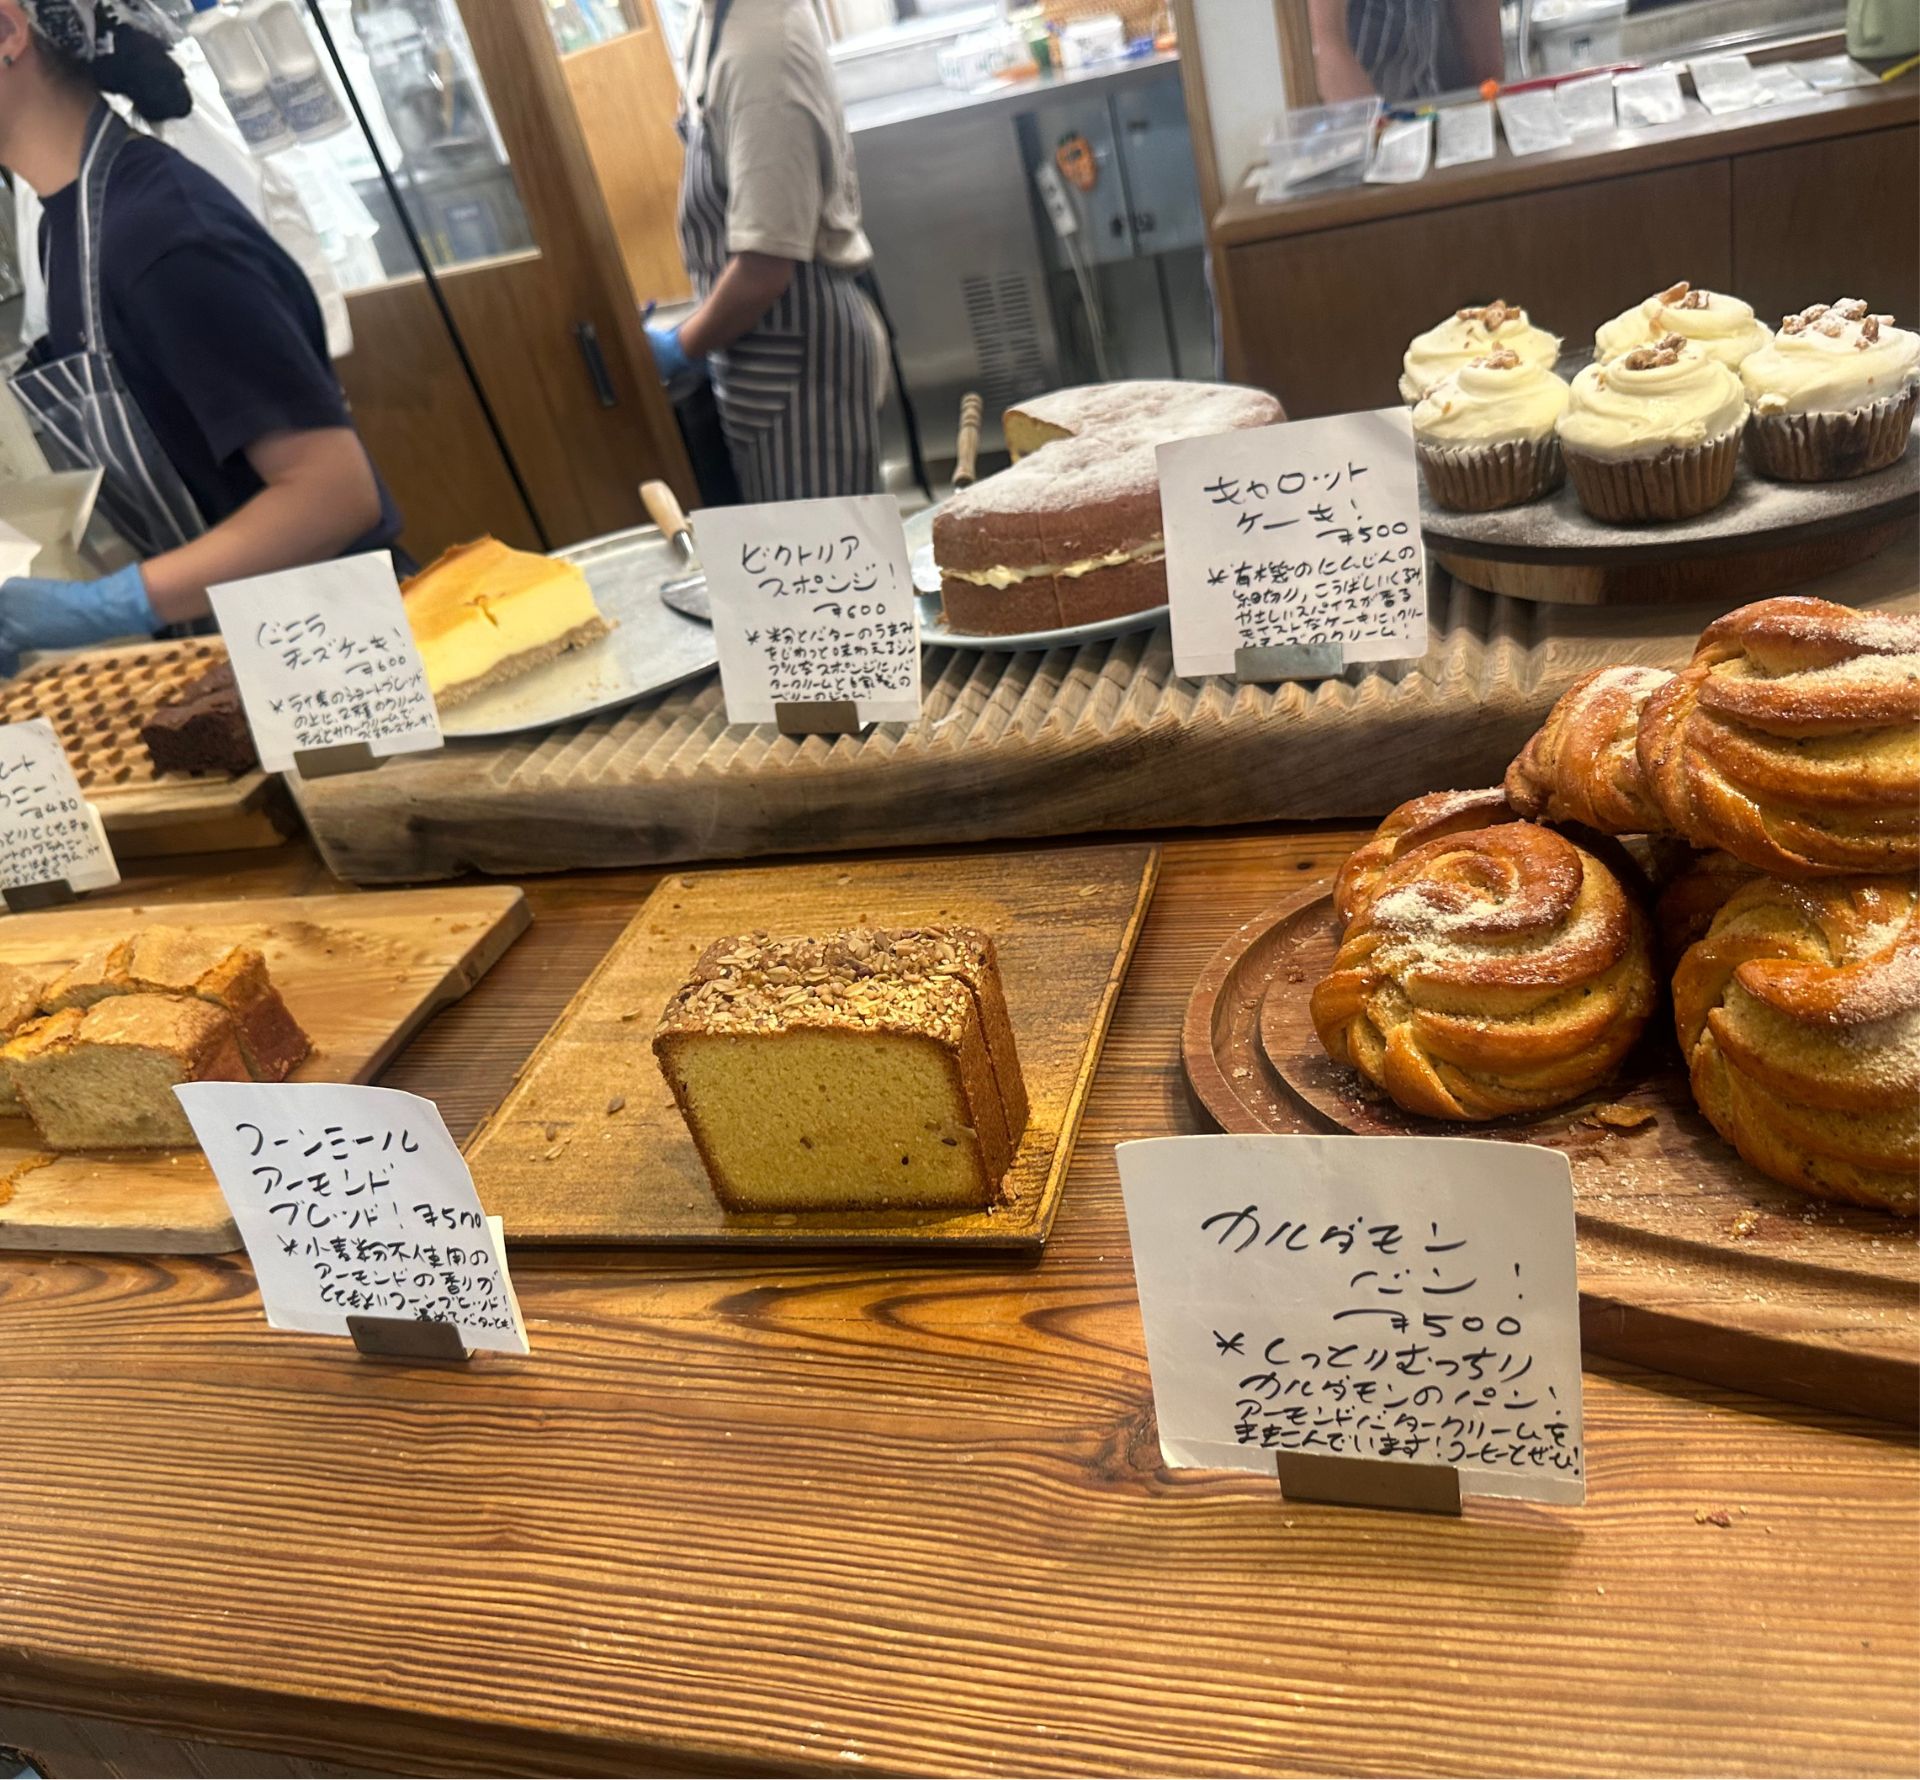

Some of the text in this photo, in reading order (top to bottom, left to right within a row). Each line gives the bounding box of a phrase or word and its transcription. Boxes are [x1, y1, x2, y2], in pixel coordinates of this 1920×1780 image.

[1203, 461, 1368, 505] キャロット
[742, 535, 859, 575] ビクトリア
[256, 613, 326, 647] バニラ
[235, 1123, 419, 1160] コーンミール
[252, 1163, 394, 1196] アーモンド
[1201, 1204, 1467, 1254] カルダモン
